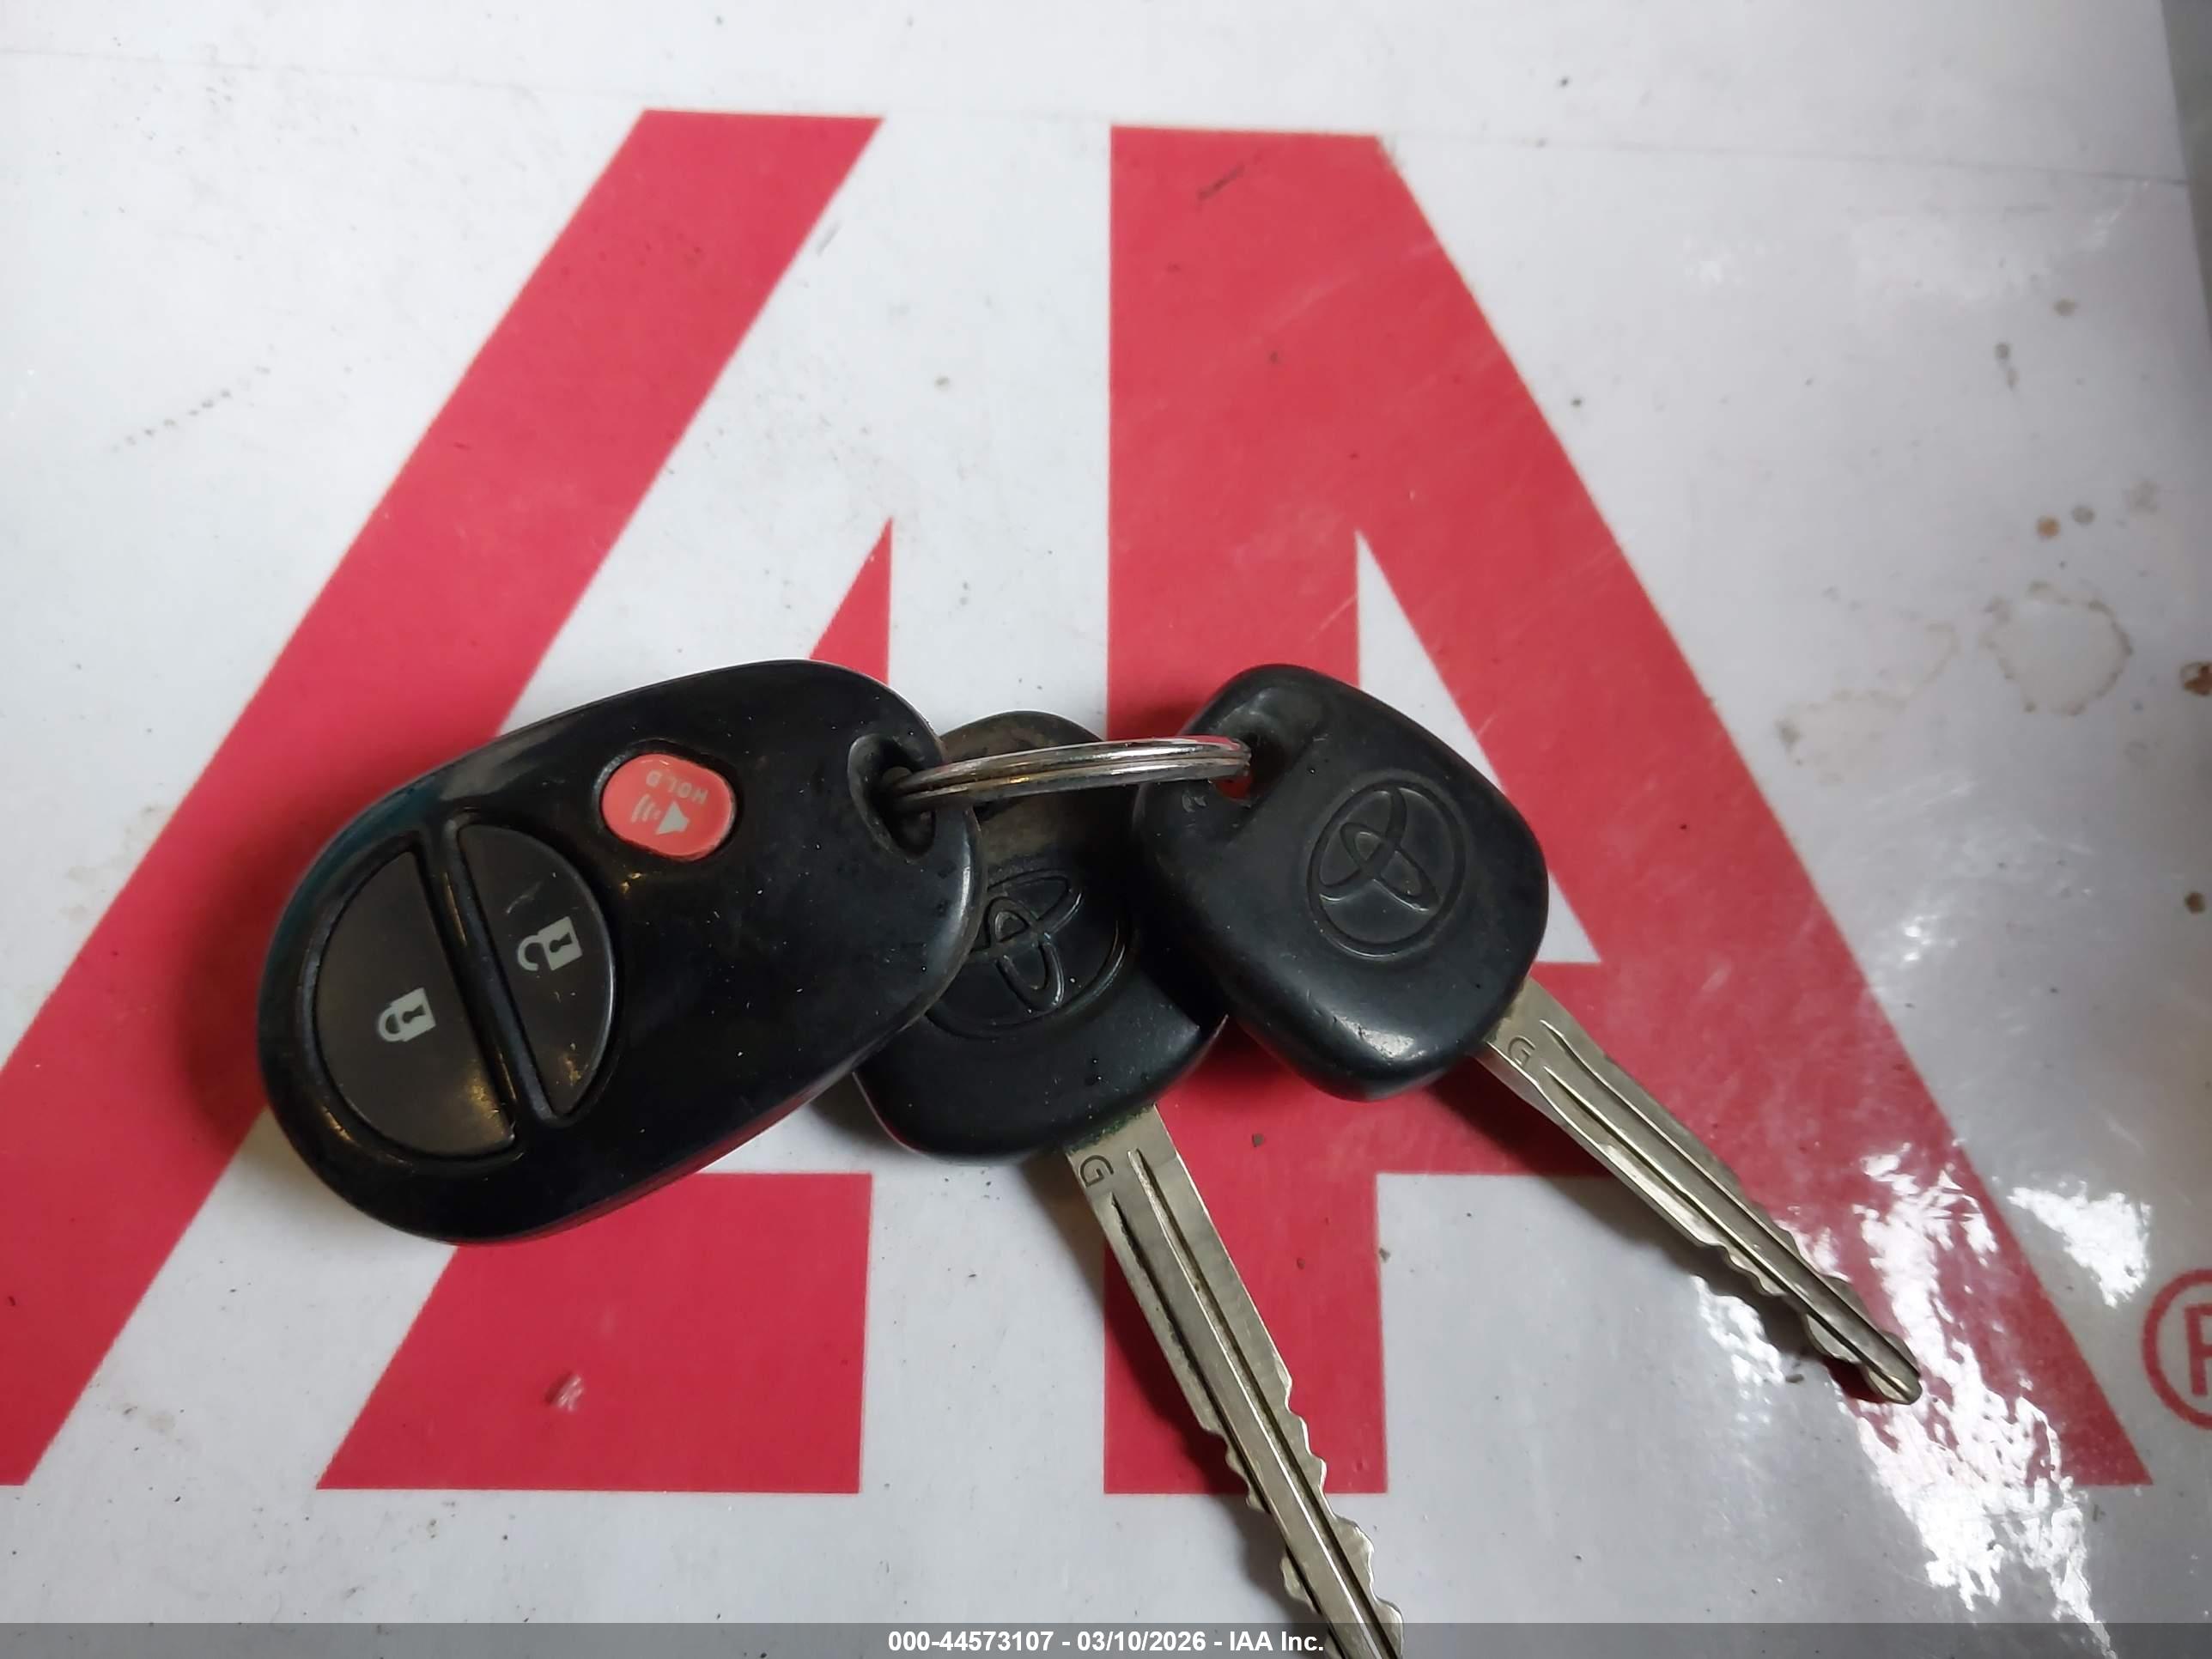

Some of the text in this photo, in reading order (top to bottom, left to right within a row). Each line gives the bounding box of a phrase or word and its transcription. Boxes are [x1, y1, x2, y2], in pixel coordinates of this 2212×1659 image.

[646, 769, 708, 805] HOLD
[1508, 1036, 1535, 1068] G
[1079, 1154, 1114, 1187] G
